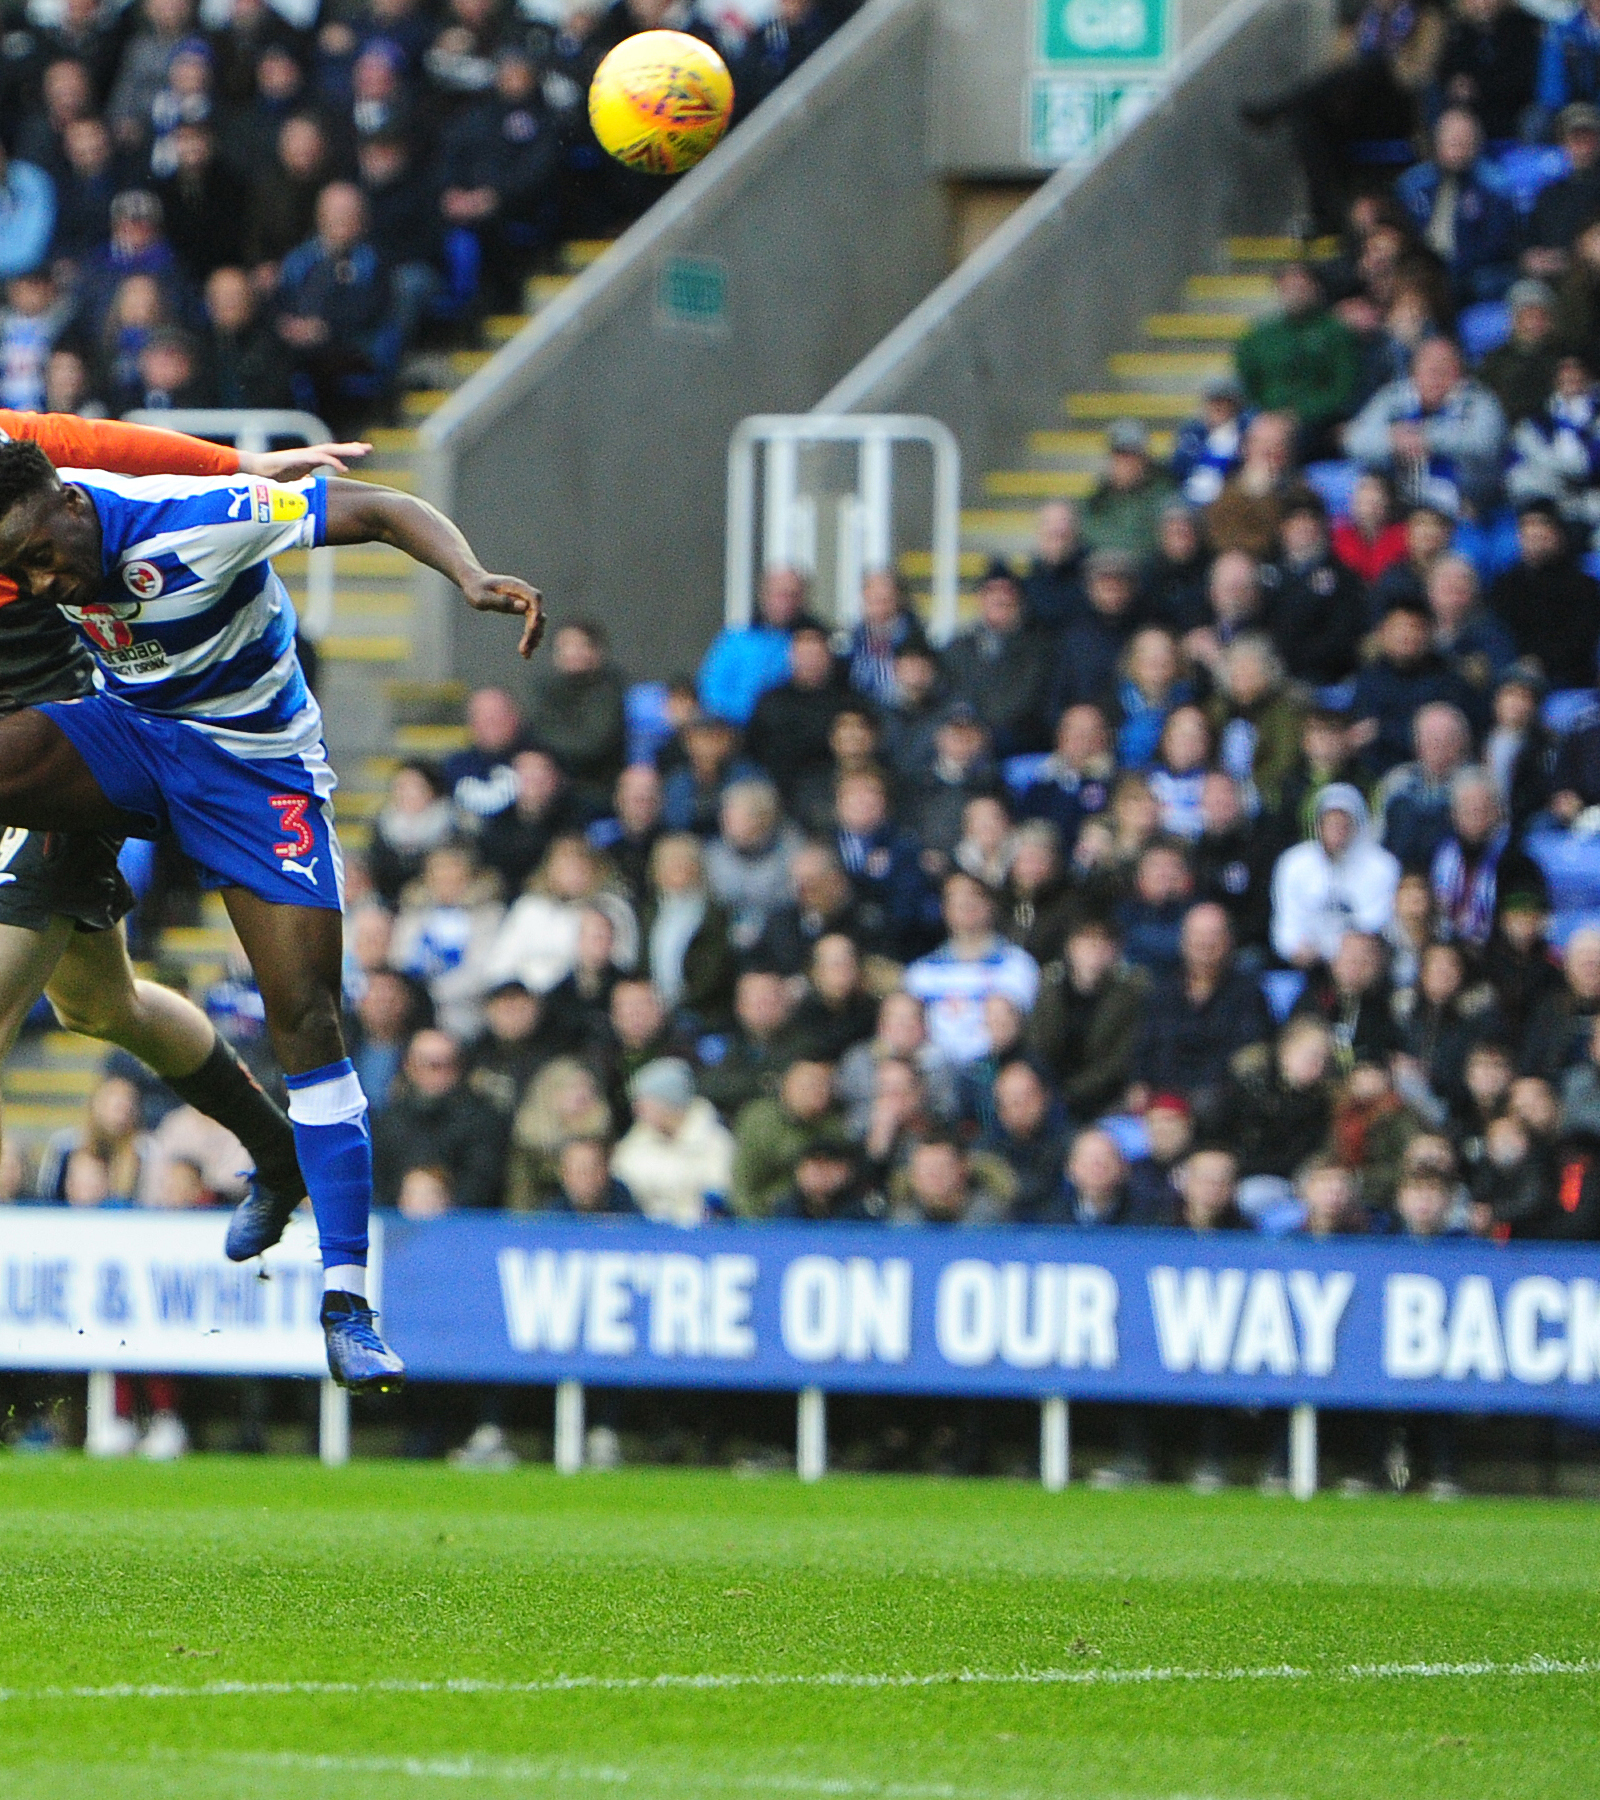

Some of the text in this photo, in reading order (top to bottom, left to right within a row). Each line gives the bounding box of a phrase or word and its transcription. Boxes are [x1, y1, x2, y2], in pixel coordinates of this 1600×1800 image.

[100, 639, 163, 665] rabao
[268, 794, 314, 858] 3
[93, 1254, 130, 1326] &
[500, 1247, 758, 1359] WE'RE
[780, 1254, 913, 1364] ON
[935, 1257, 1120, 1371] OUR
[1146, 1265, 1356, 1378] WAY
